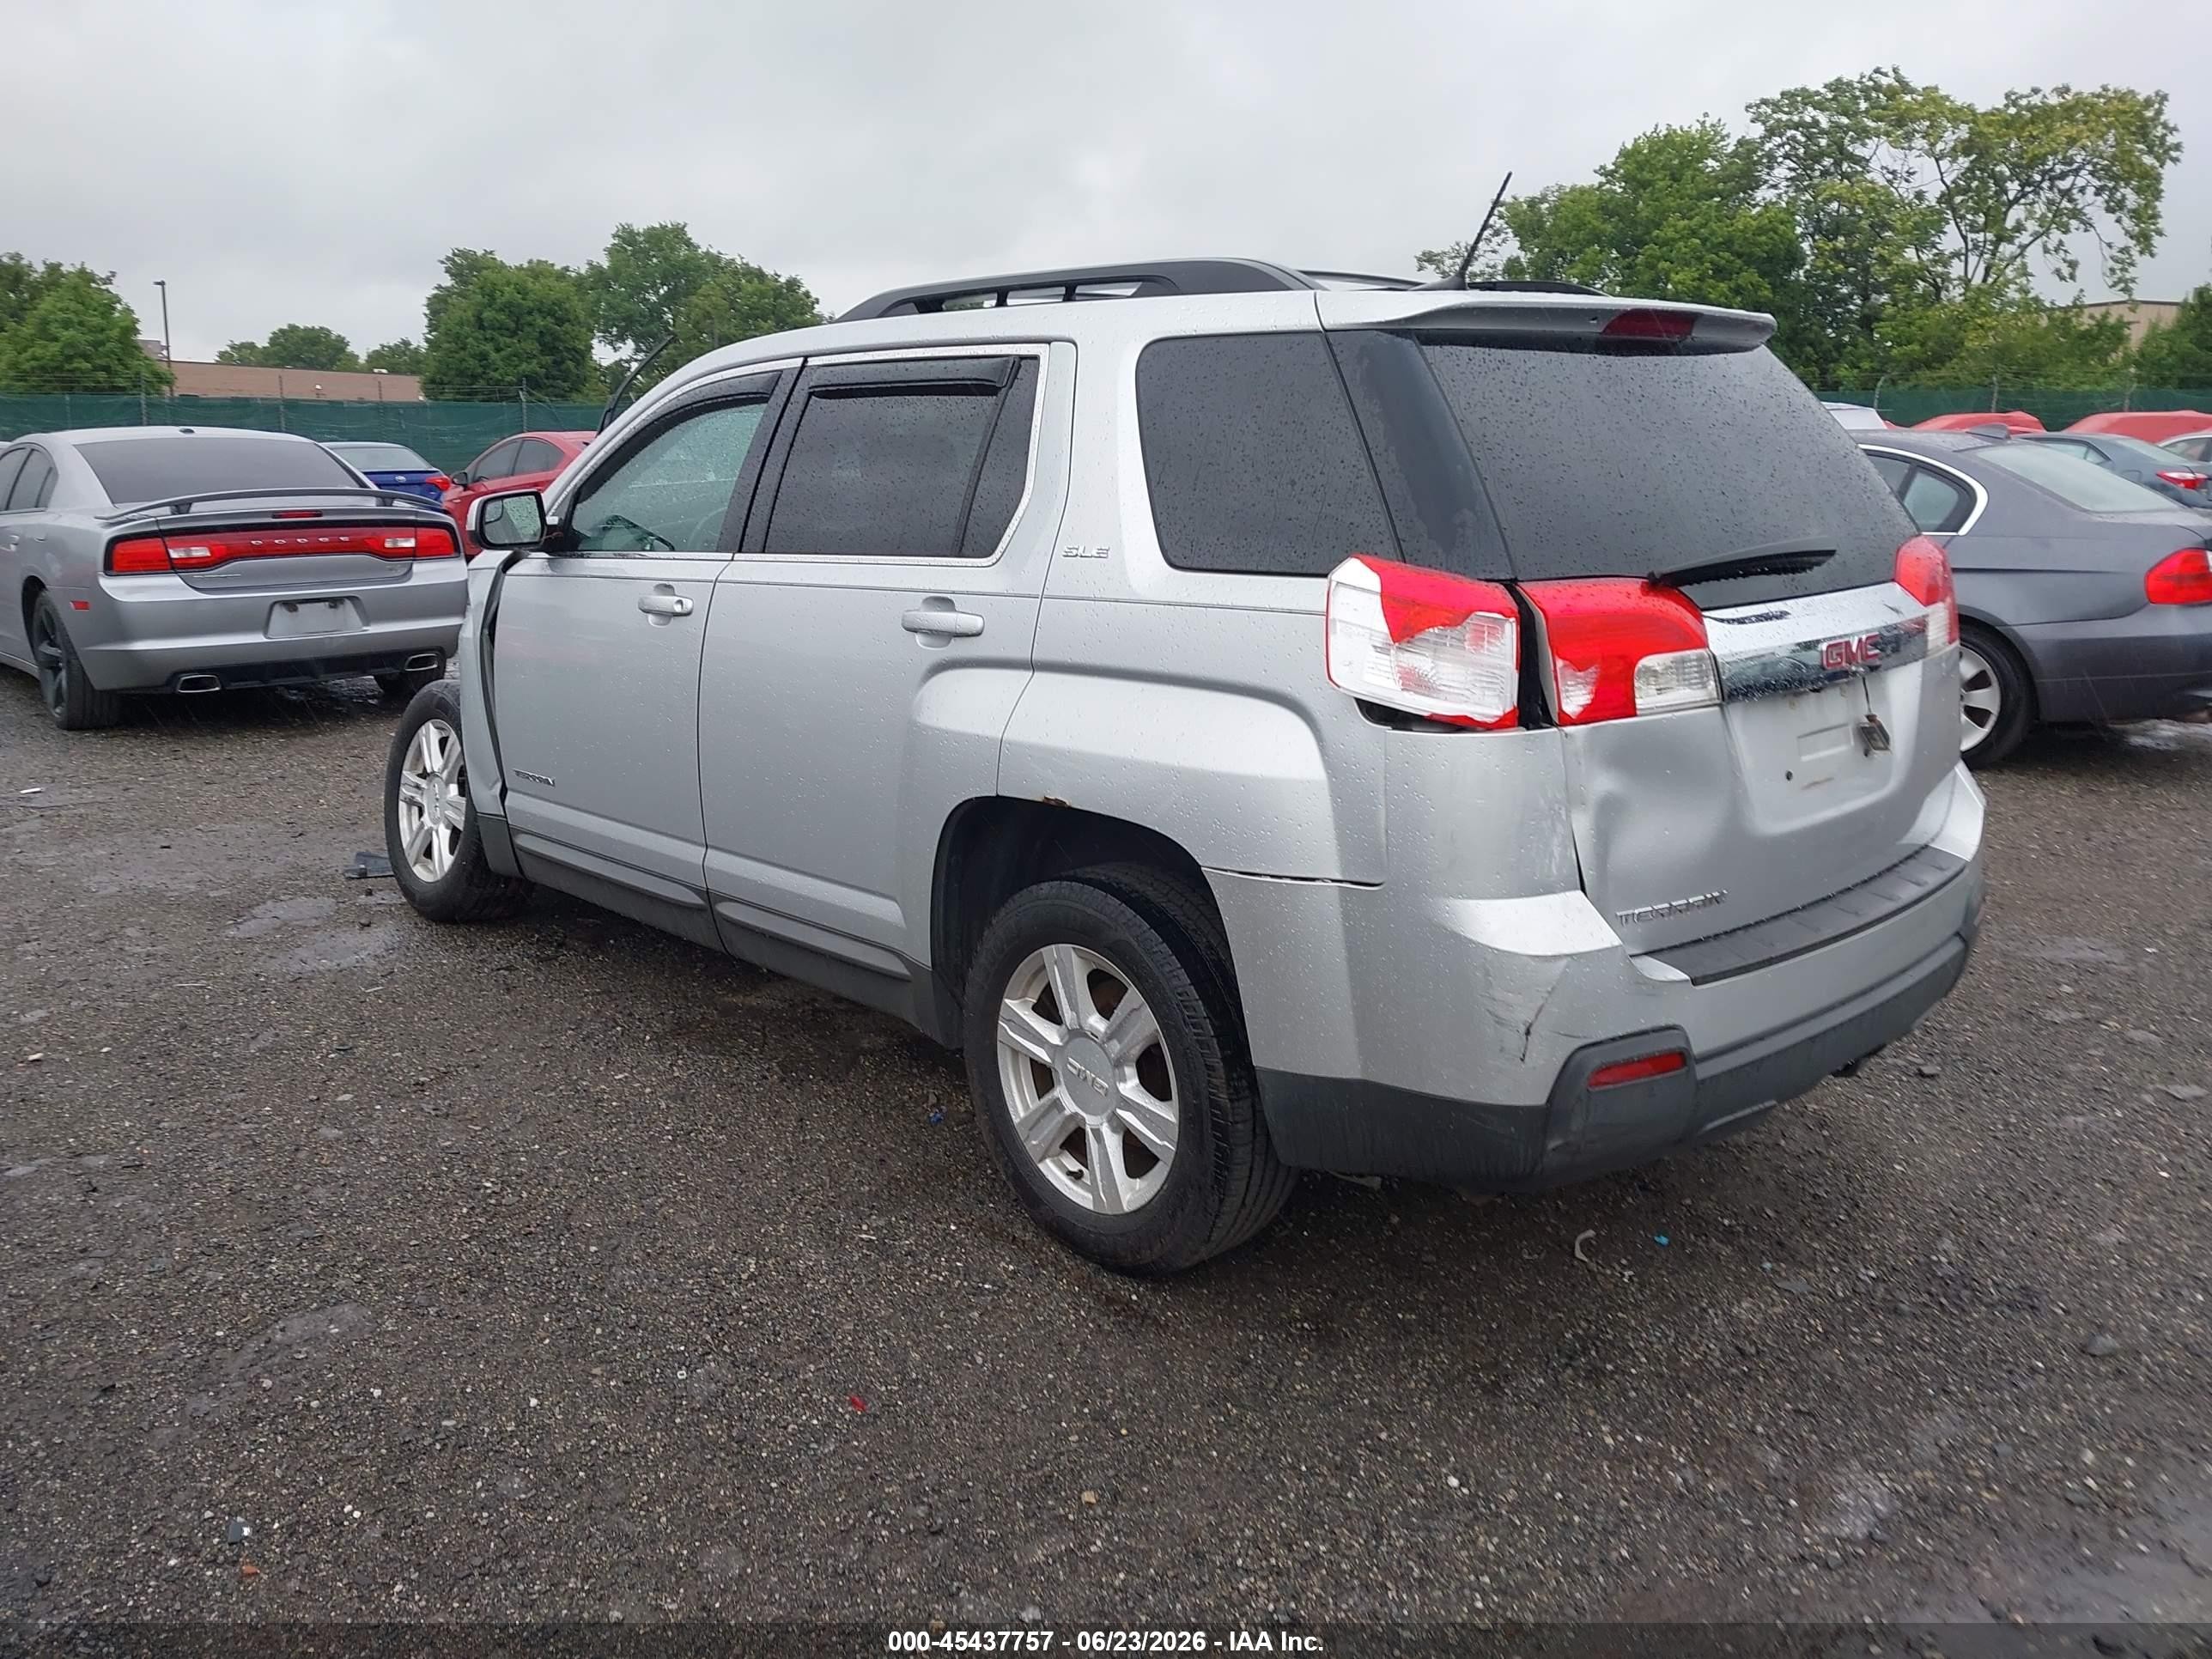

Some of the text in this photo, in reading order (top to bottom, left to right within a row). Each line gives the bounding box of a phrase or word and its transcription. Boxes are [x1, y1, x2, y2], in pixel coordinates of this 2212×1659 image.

[251, 535, 350, 546] DODGE
[1062, 545, 1109, 558] SLE
[1821, 633, 1882, 671] GMC
